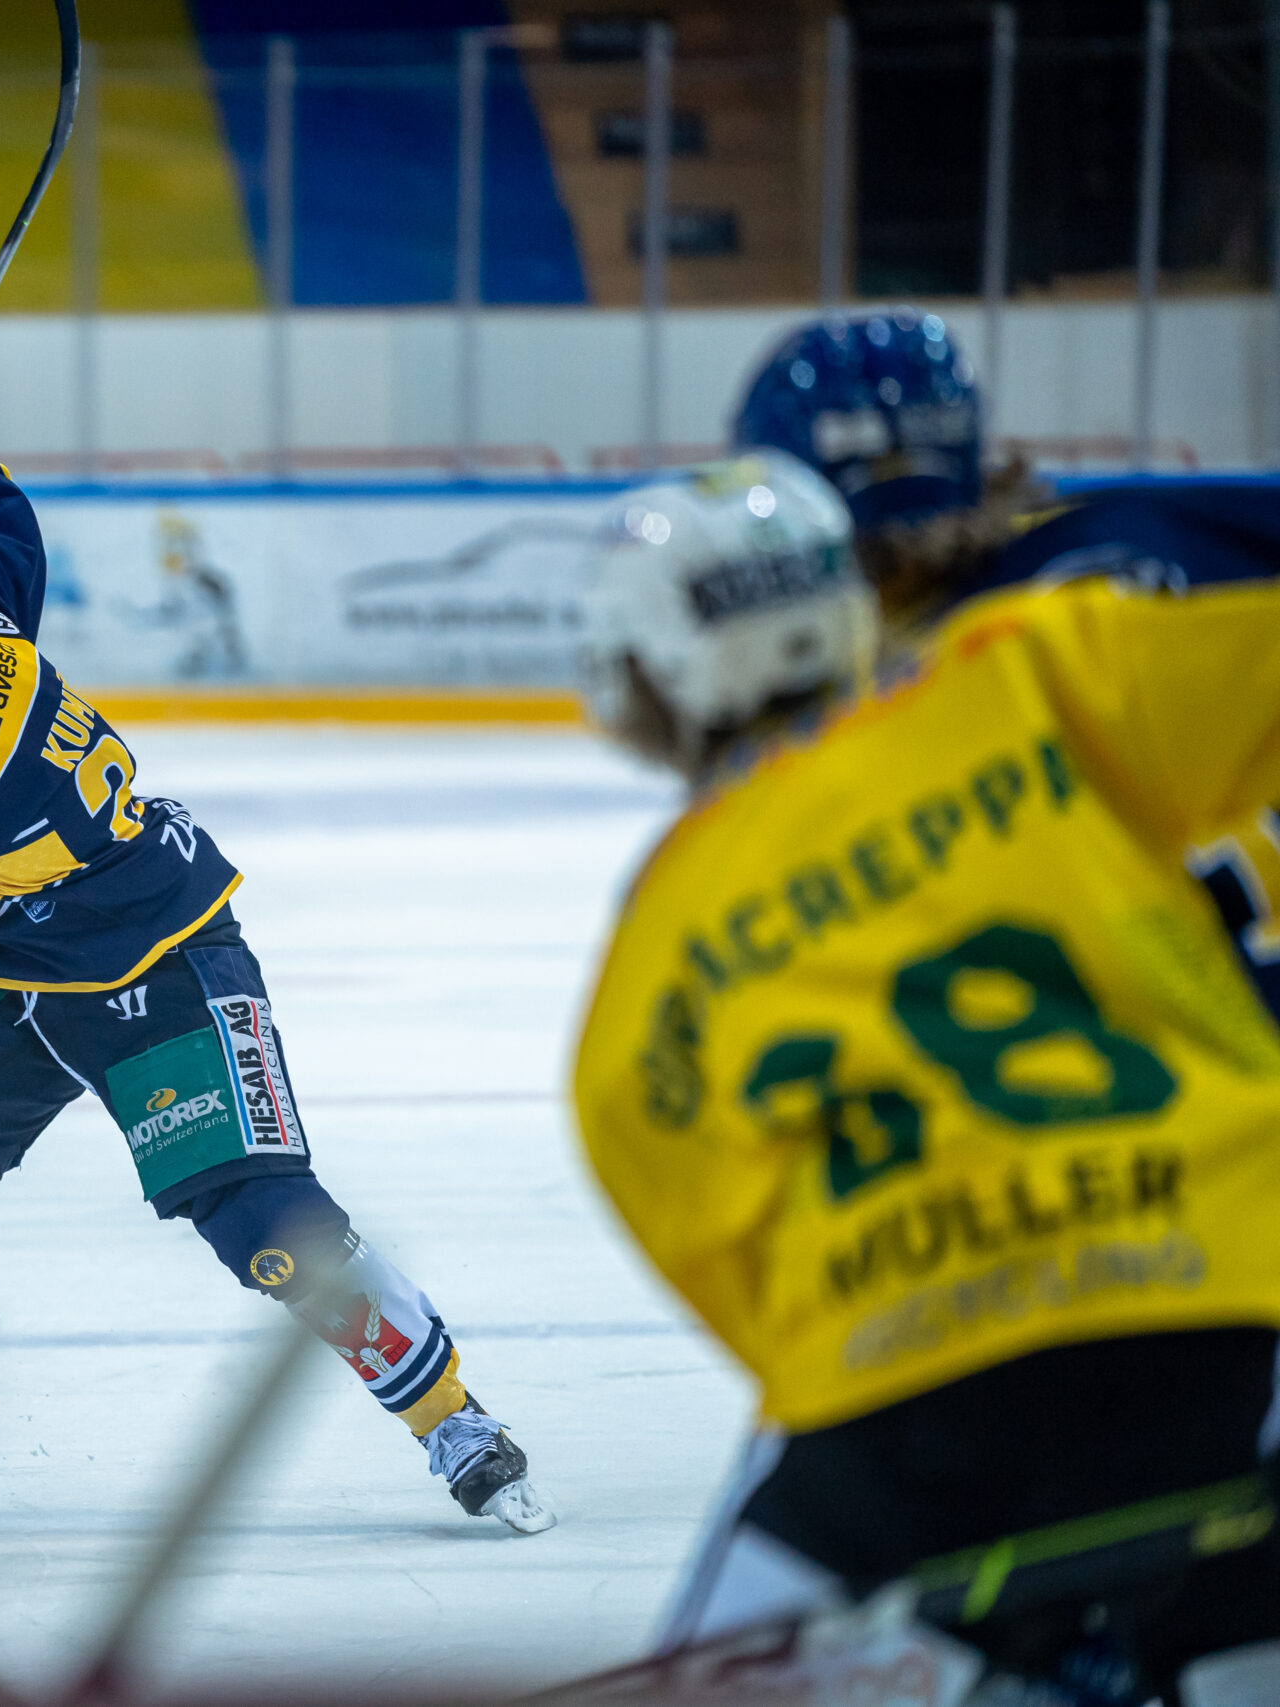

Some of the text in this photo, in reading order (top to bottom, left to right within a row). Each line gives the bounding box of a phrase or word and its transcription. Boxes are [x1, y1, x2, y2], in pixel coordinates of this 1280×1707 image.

[75, 734, 145, 843] 2
[126, 1089, 227, 1152] MOTOREX
[221, 1001, 282, 1145] HESAB AG
[257, 1002, 301, 1147] HAUSTECHNIK
[133, 1113, 229, 1164] Oil of Switzerland
